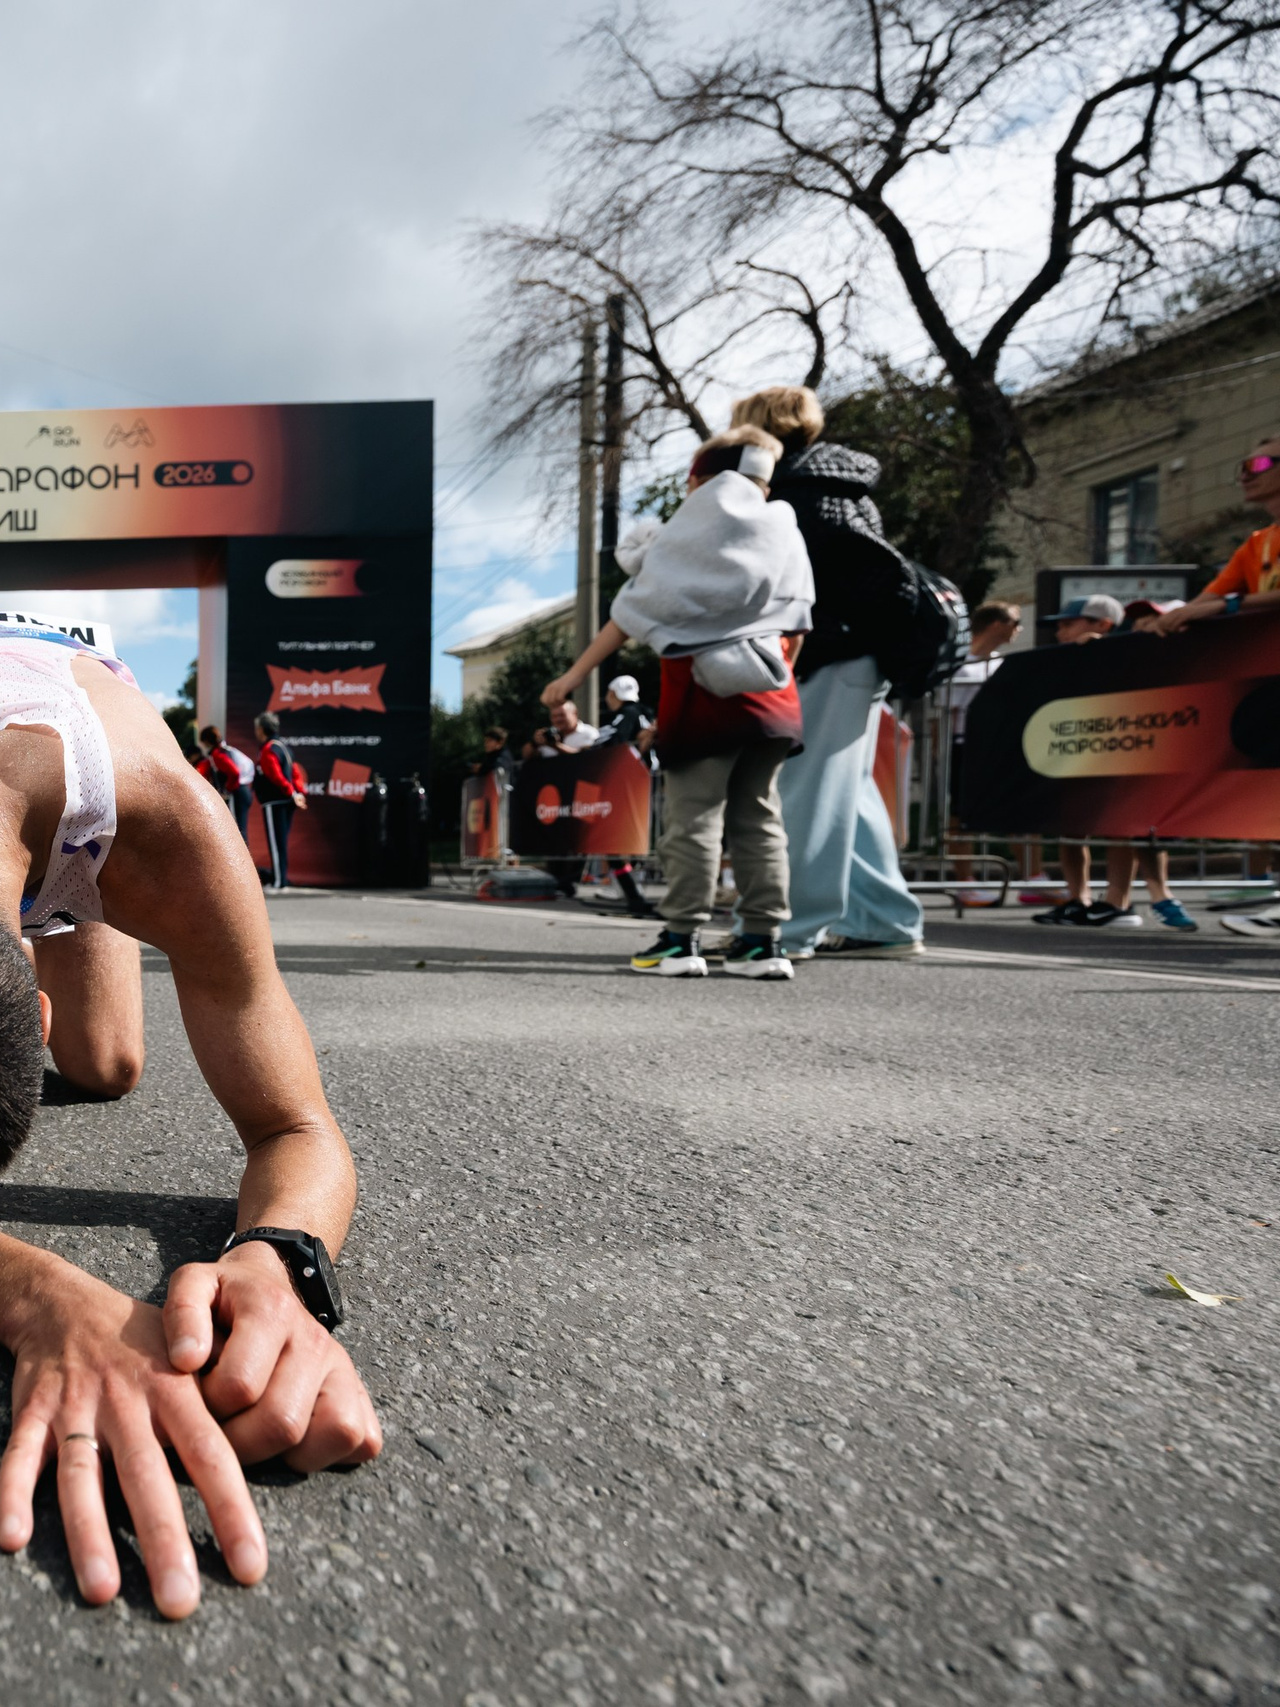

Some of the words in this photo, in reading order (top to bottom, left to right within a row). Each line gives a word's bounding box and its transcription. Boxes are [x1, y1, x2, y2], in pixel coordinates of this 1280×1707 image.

[162, 464, 217, 485] 2026
[280, 680, 331, 699] Альфа
[332, 680, 371, 695] Банк
[1048, 705, 1200, 736] ЧЕЛЯБИНСКИЙ
